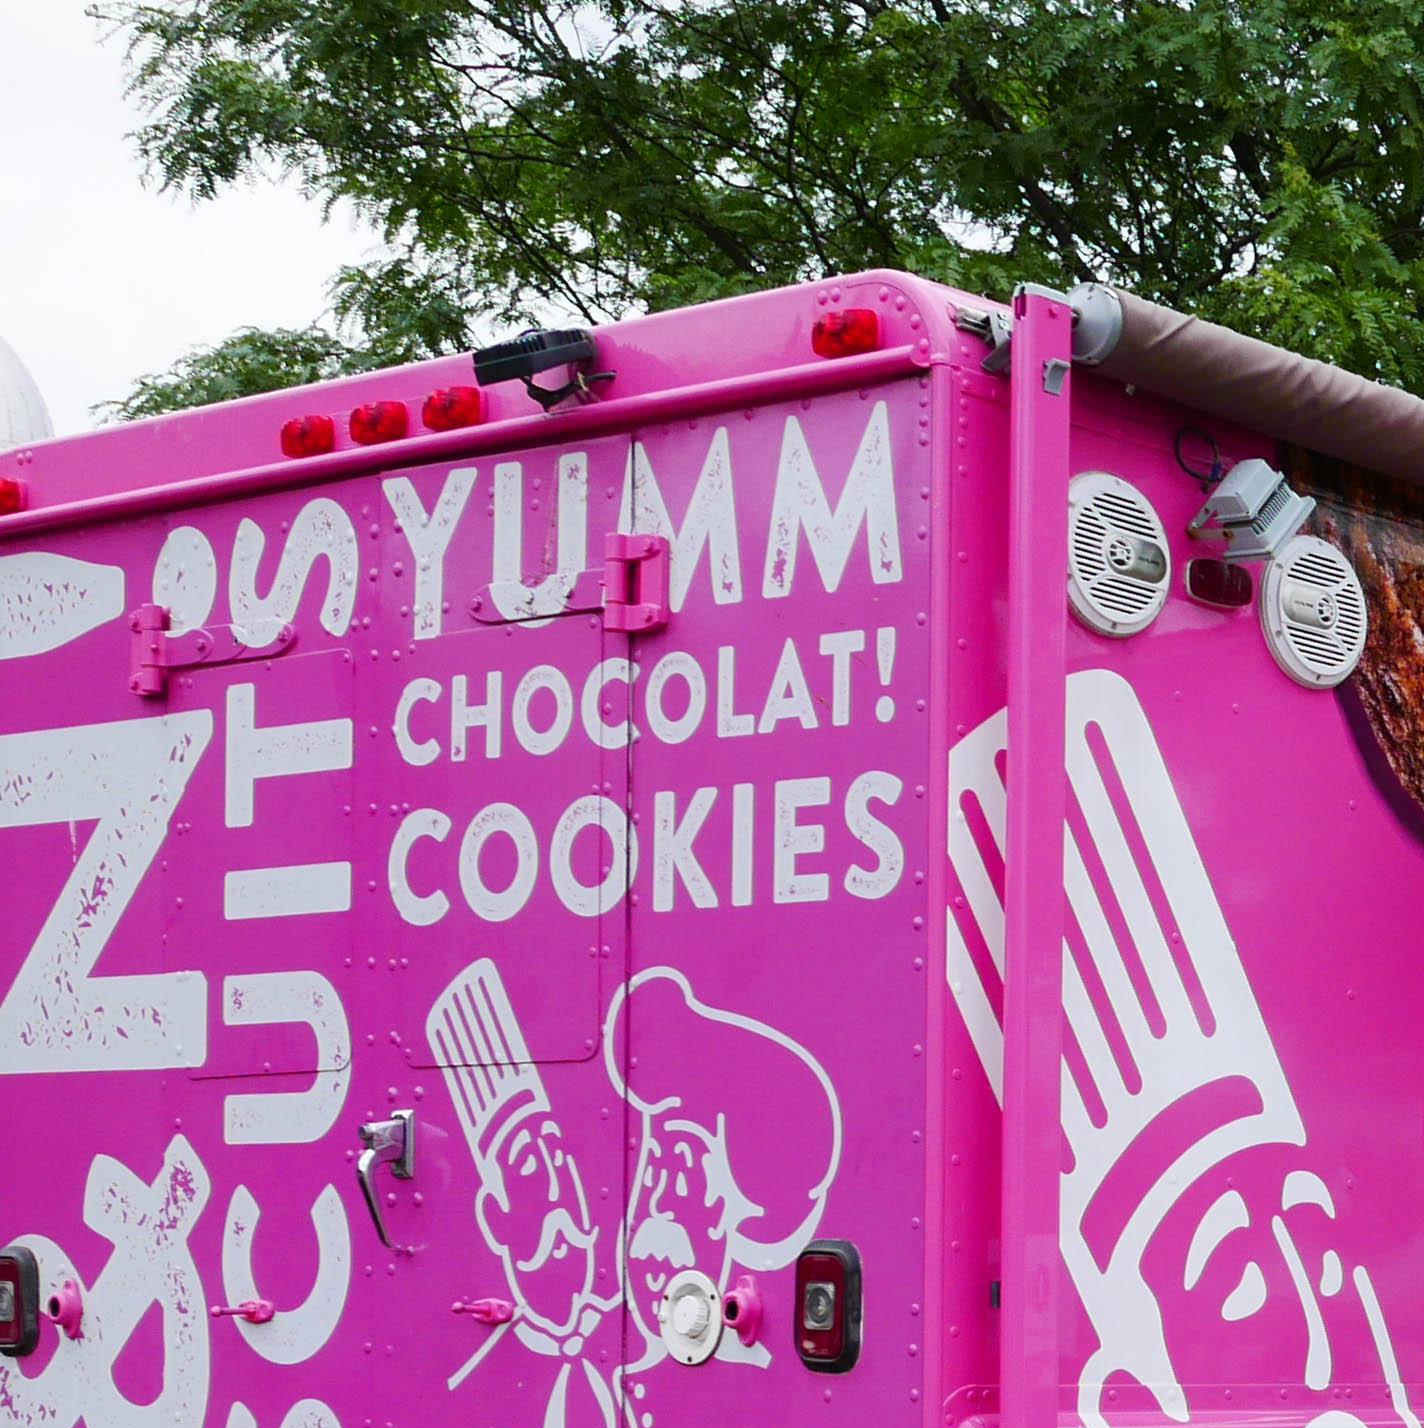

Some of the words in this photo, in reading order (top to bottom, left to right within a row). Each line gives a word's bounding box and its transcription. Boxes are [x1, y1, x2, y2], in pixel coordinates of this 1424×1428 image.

[383, 400, 902, 640] YUMM
[394, 626, 896, 766] CHOCOLAT!
[388, 770, 902, 927] COOKIES
